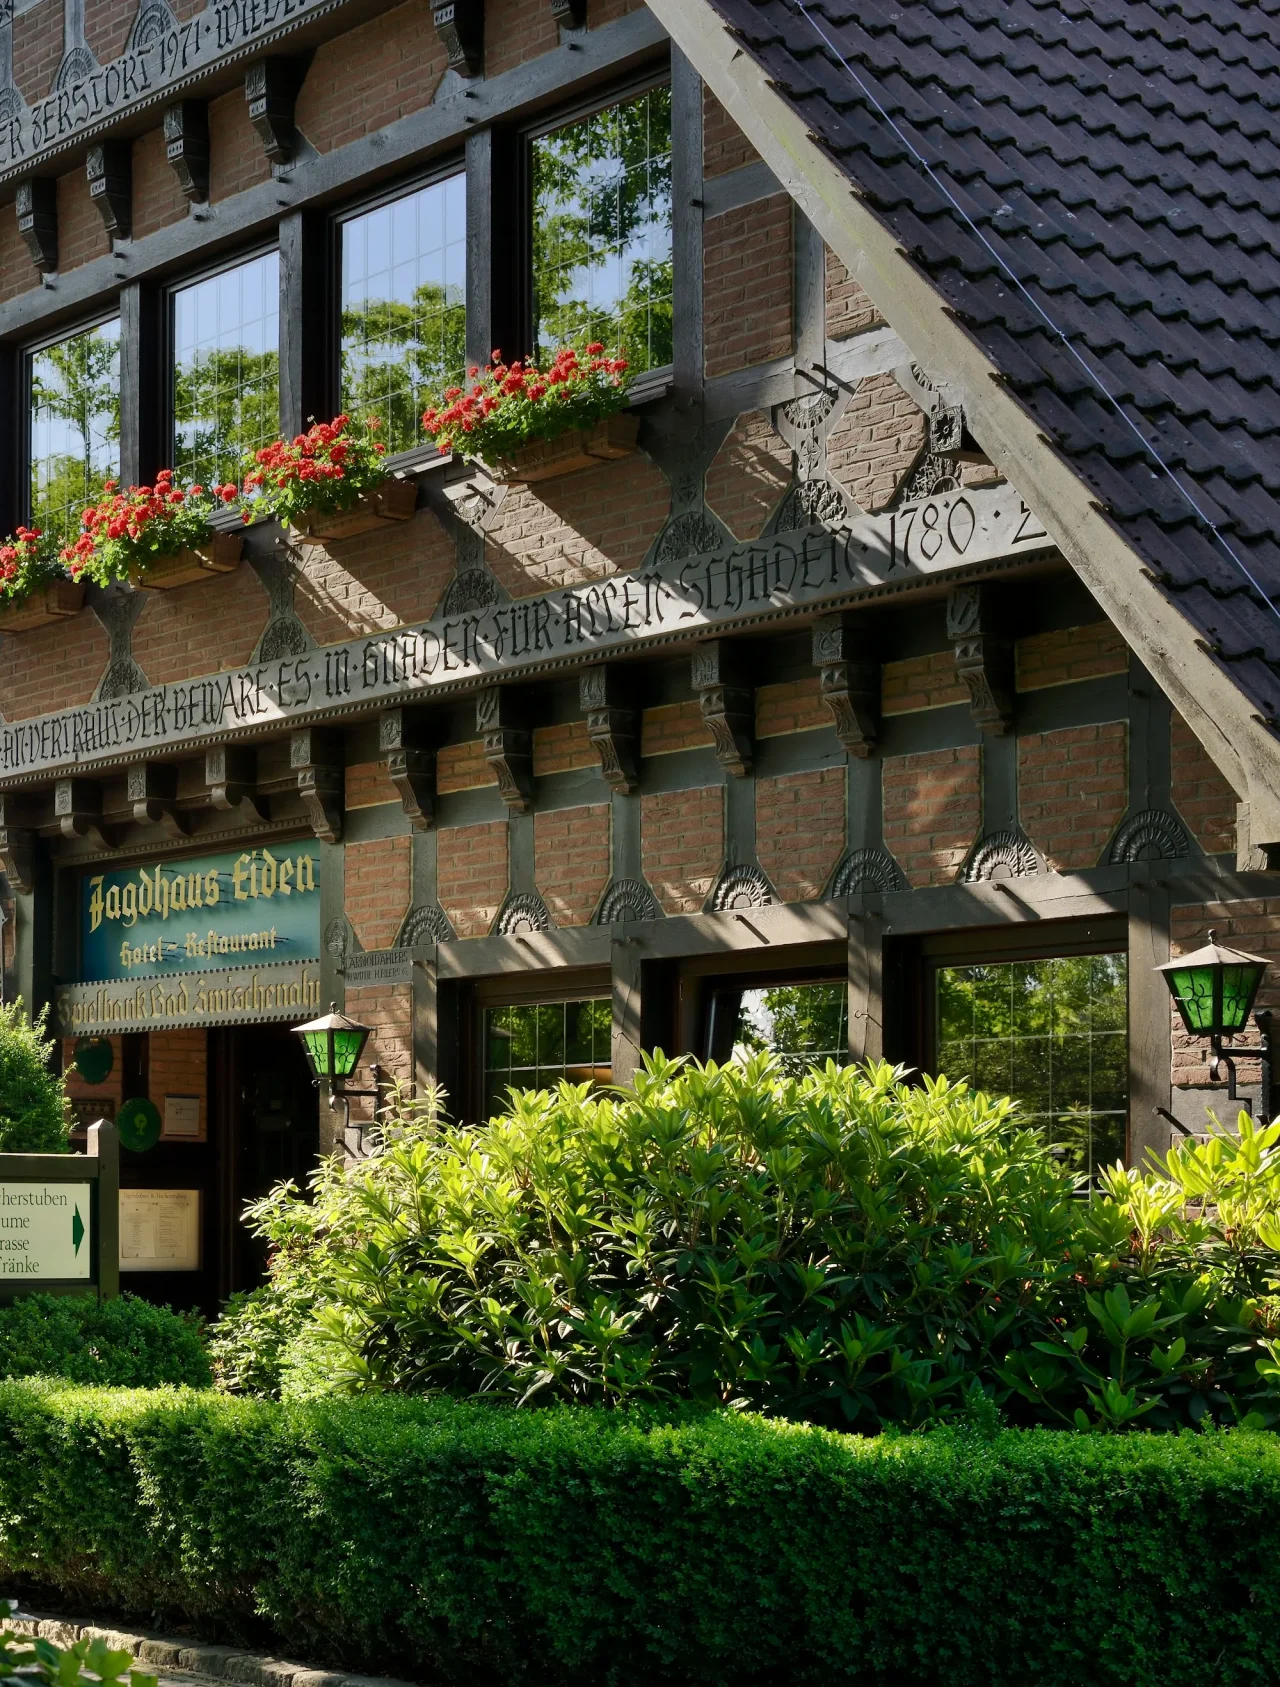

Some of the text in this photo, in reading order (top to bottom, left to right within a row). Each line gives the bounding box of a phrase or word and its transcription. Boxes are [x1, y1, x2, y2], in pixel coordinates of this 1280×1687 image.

[159, 18, 201, 77] 1971
[126, 687, 167, 743] DER
[277, 658, 313, 707] ES
[324, 647, 351, 699] IN
[678, 524, 857, 619] SCHADEN
[887, 496, 976, 573] 1780
[89, 848, 316, 933] Jagdhaus Eiden
[119, 936, 164, 969] Hotel
[57, 985, 148, 1030] Spielbank
[149, 979, 189, 1018] Bad
